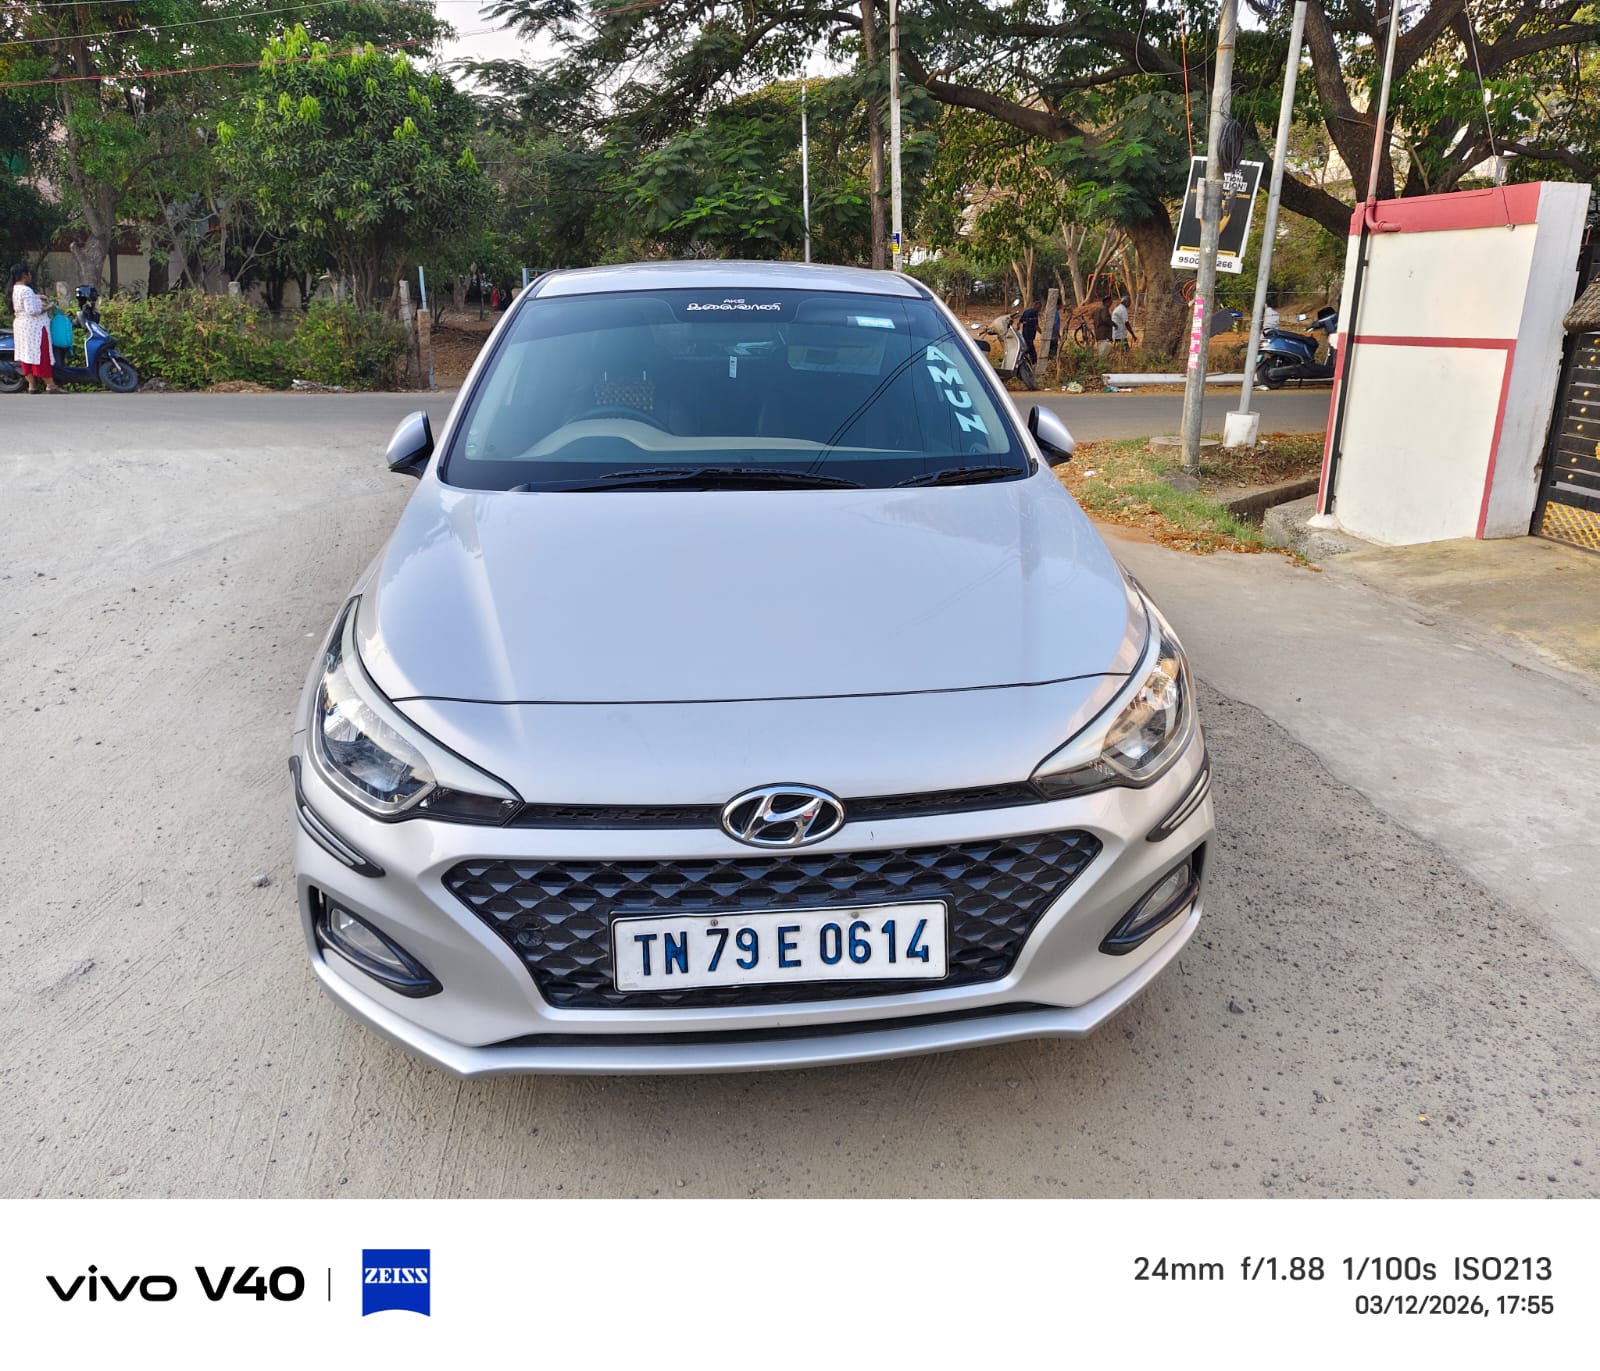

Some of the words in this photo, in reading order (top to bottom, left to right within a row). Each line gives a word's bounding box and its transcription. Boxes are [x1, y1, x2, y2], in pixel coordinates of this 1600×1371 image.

[1178, 256, 1233, 269] 9500266
[633, 930, 689, 977] TN
[706, 927, 760, 972] 79
[777, 925, 802, 969] E
[819, 918, 930, 966] 0614
